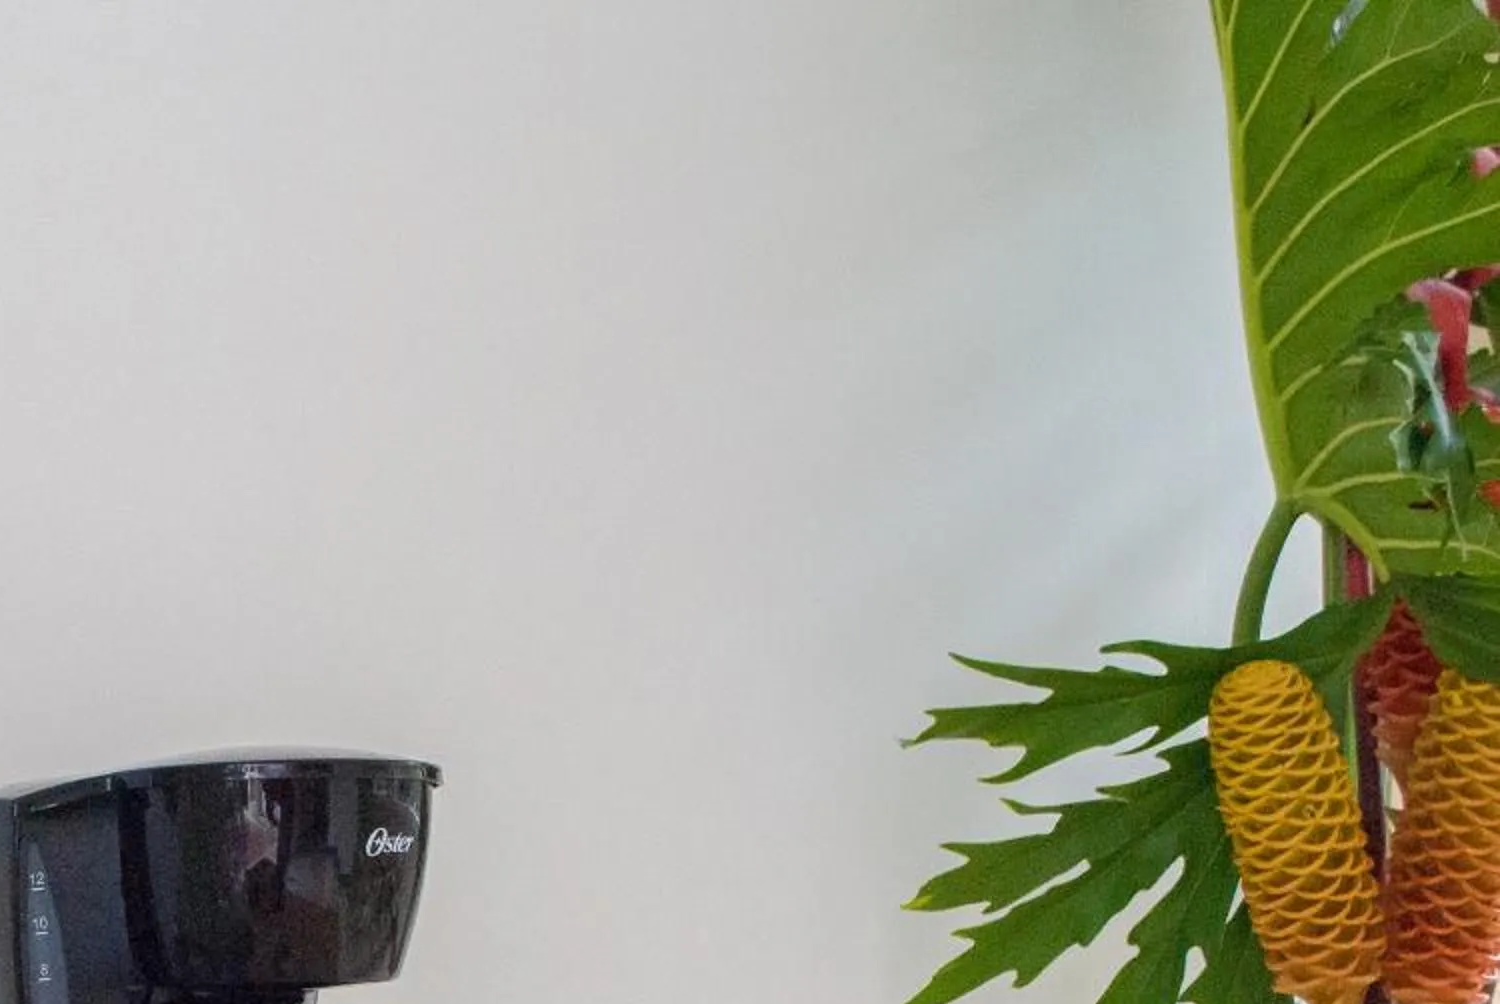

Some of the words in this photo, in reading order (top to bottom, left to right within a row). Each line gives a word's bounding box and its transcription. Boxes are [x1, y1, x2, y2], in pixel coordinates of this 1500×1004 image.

[365, 827, 414, 857] Oster
[29, 871, 45, 885] 12
[32, 915, 49, 930] 10
